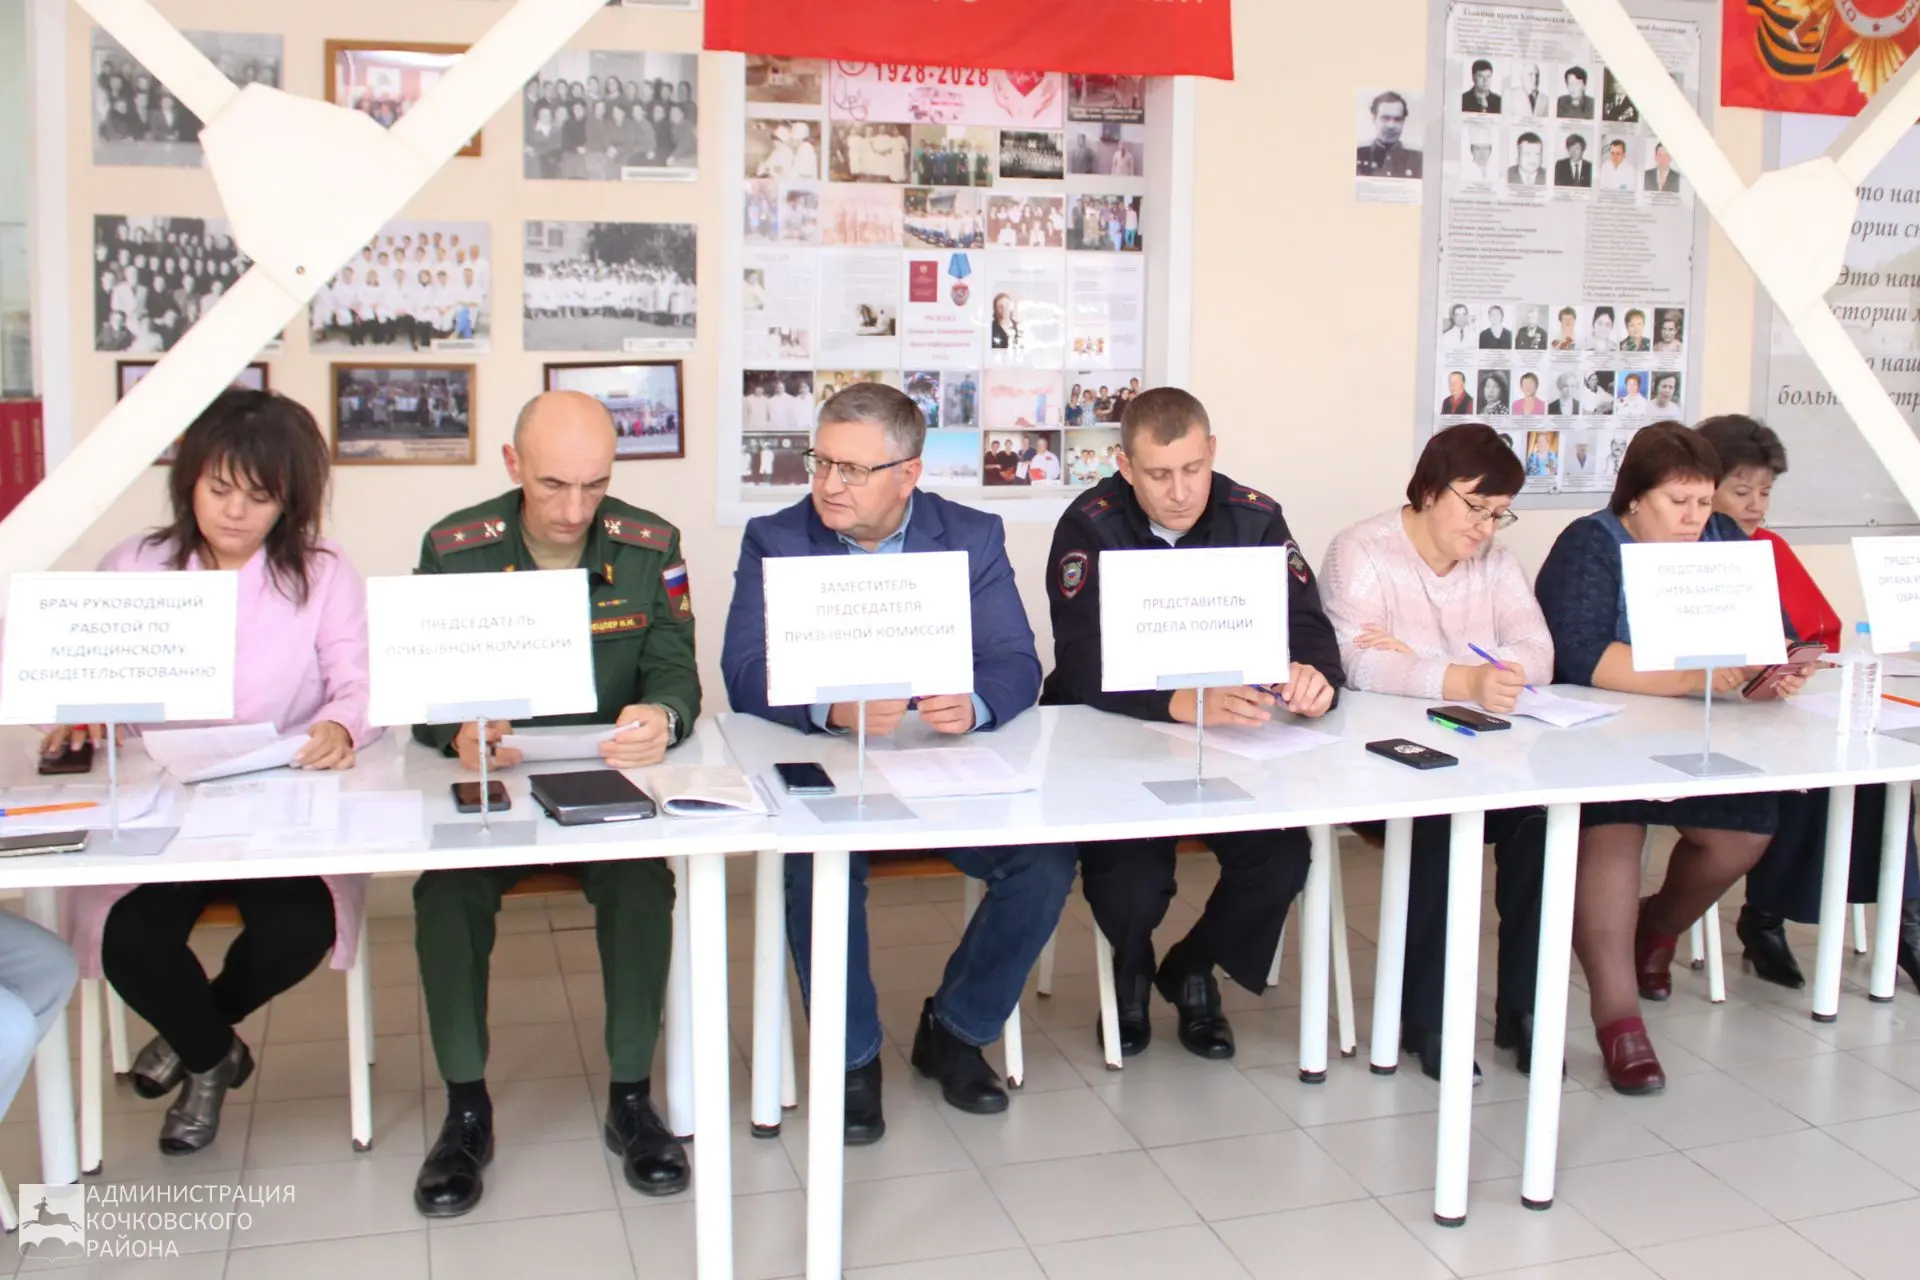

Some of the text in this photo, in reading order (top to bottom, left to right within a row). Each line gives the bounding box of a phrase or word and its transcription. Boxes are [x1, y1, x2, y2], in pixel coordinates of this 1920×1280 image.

[1856, 185, 1884, 201] то
[1851, 220, 1899, 242] ории
[1836, 265, 1880, 286] Это
[1832, 305, 1907, 328] стории
[1778, 385, 1842, 406] больн
[820, 579, 917, 594] ЗАМЕСТИТЕЛЬ
[39, 594, 204, 611] ВРАЧ РУКОВОДЯЩИЙ
[816, 601, 922, 617] ПРЕДСЕДАТЕЛЯ
[1143, 595, 1247, 610] ПРЕДСТАВИТЕЛЬ
[69, 620, 170, 634] РАБОТОЙ ПО
[420, 615, 536, 631] ПРЕДСЕДАТЕЛЬ
[1137, 617, 1253, 633] ОТДЕЛА ПОЛИЦИИ
[785, 624, 955, 643] ПРИЗЫВНОЙ КОМИССИИ
[51, 643, 187, 658] МЕДИЦИНСКОМУ
[386, 637, 572, 657] ПРИЗЫВНОЙ КОМИССИИ
[18, 665, 217, 682] ОСВИДЕТЕЛЬСТВОВАНИЮ
